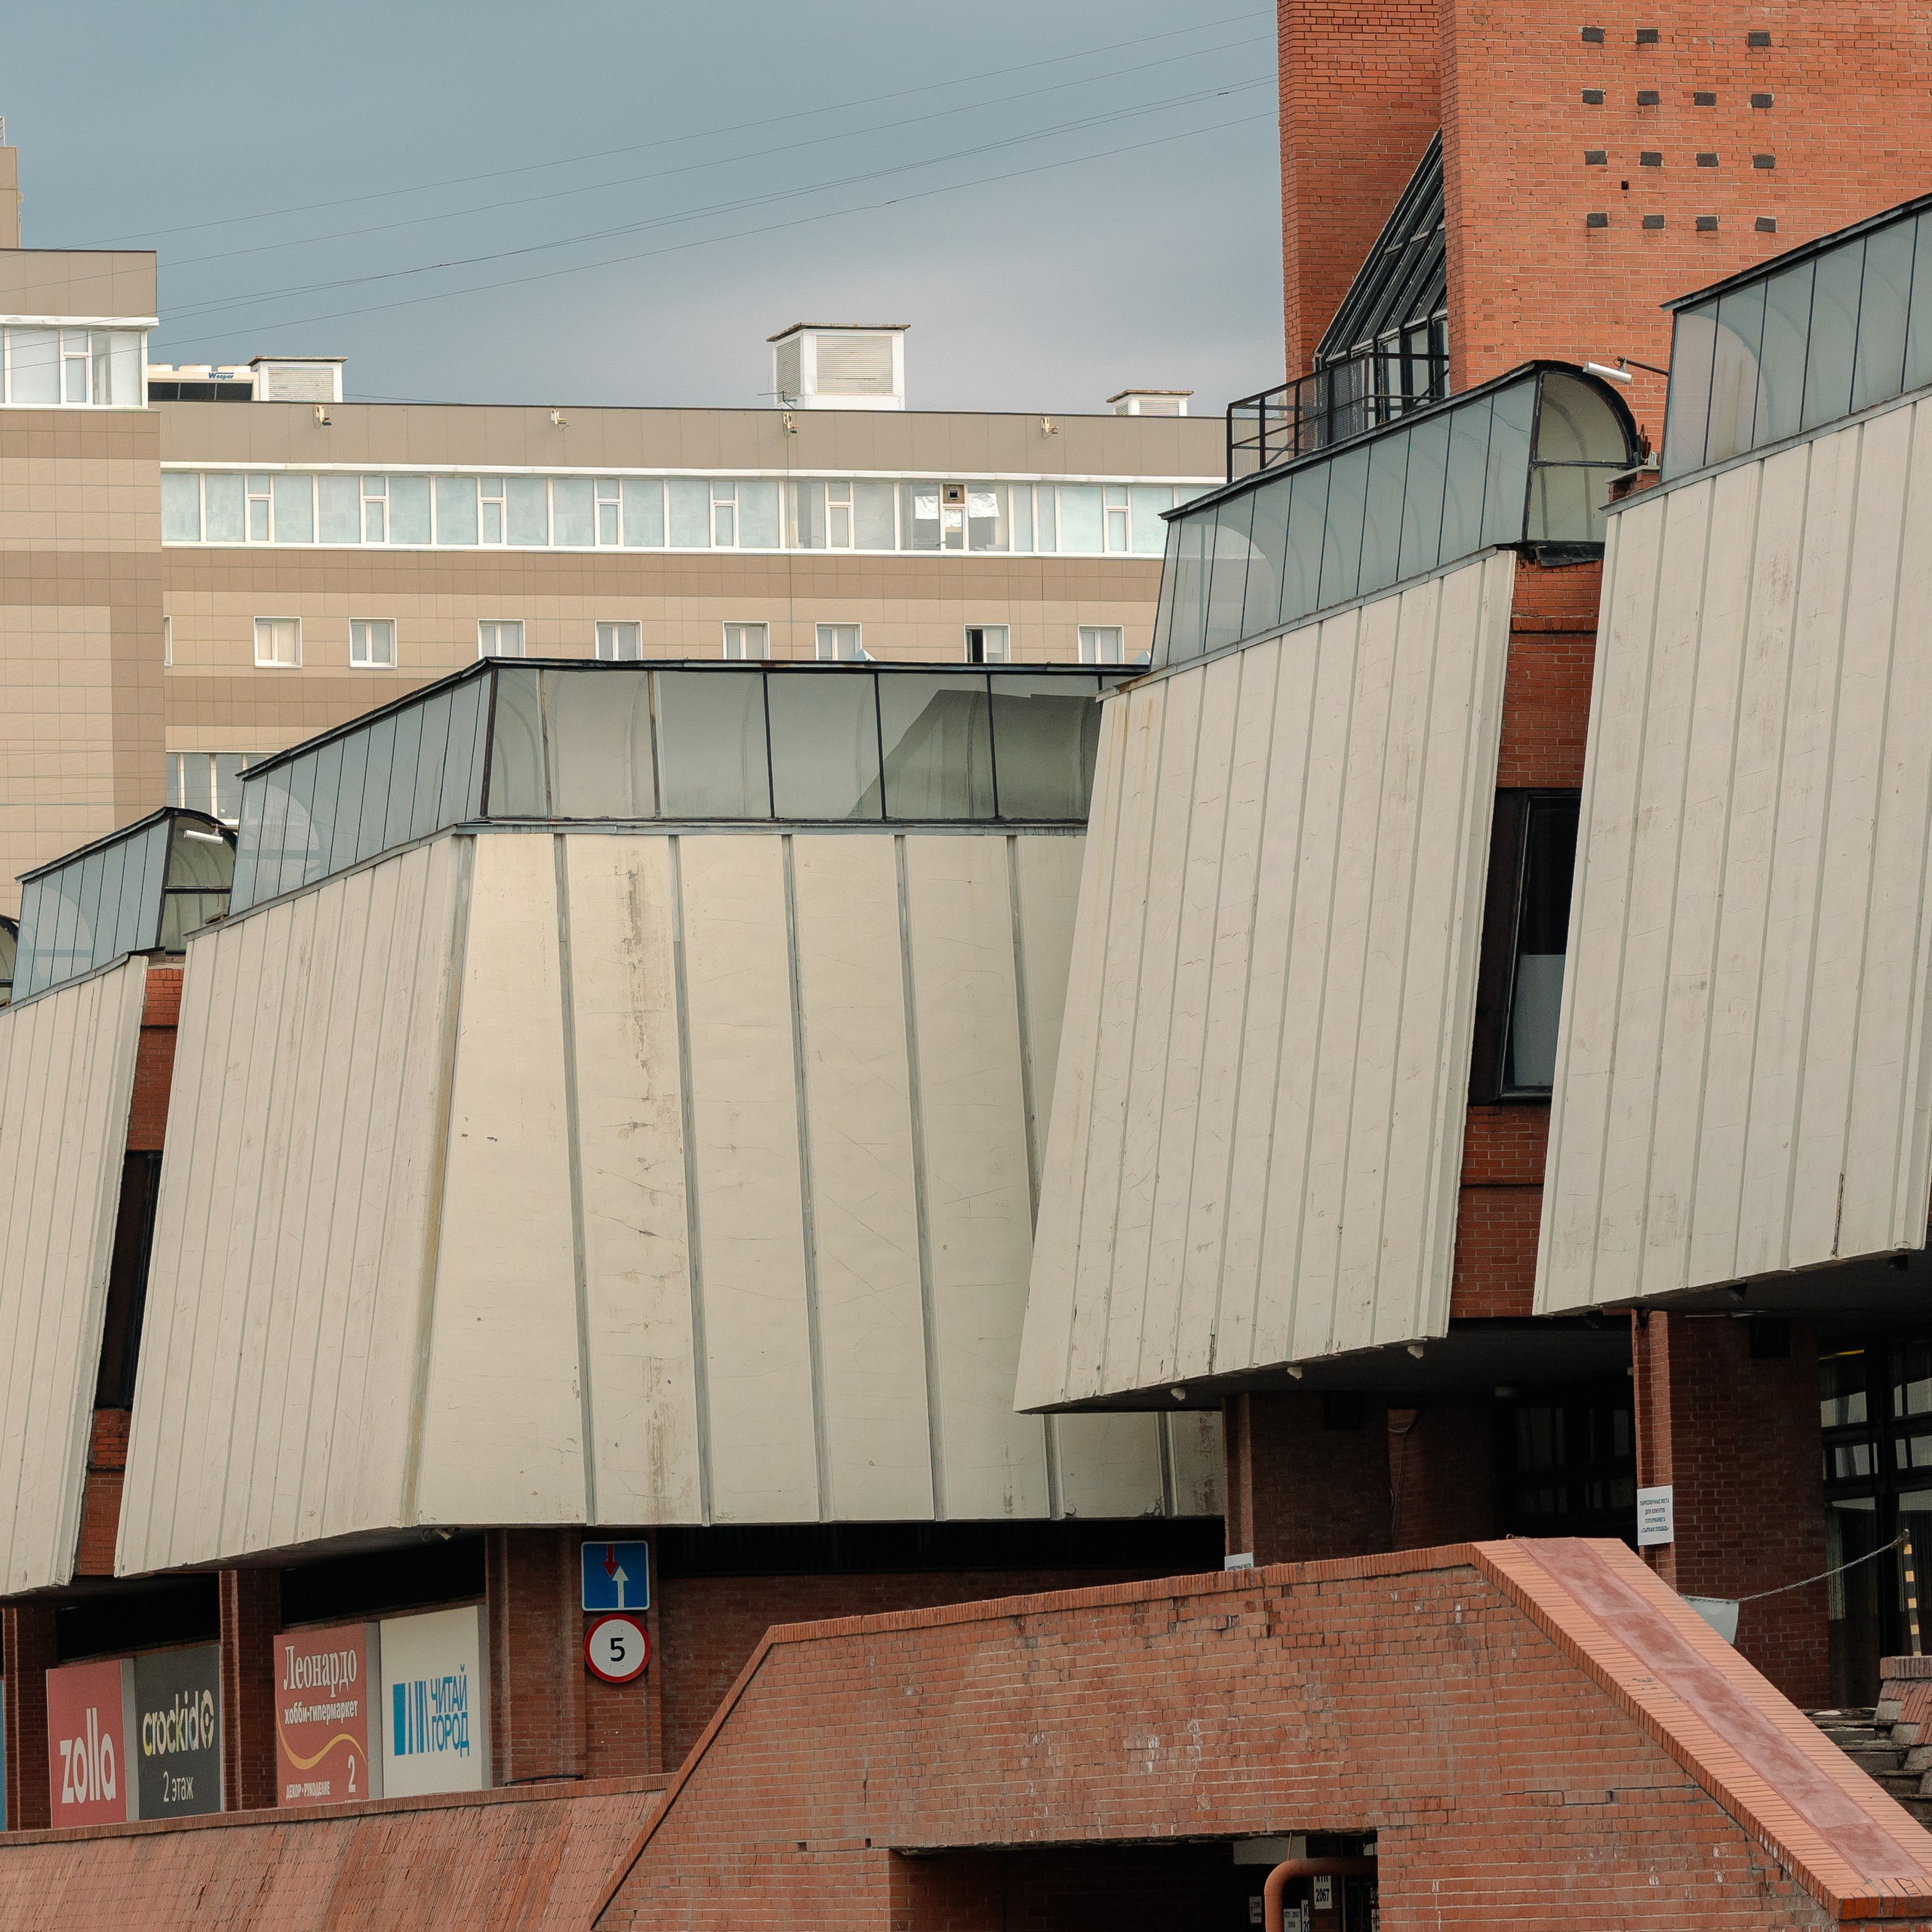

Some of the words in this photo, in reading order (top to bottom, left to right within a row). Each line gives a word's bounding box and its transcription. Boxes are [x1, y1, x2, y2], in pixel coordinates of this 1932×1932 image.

[610, 1637, 626, 1662] 5
[283, 1645, 357, 1698] Леонардо
[430, 1663, 468, 1714] ЧИТАЙ
[142, 1690, 199, 1757] crockid
[284, 1700, 358, 1726] хобби-гипермаркет
[431, 1711, 469, 1758] ГОРОД
[60, 1707, 116, 1804] zolla
[347, 1754, 356, 1793] 2
[163, 1770, 170, 1802] 2
[171, 1776, 194, 1802] этаж
[1315, 1887, 1330, 1902] 2067
